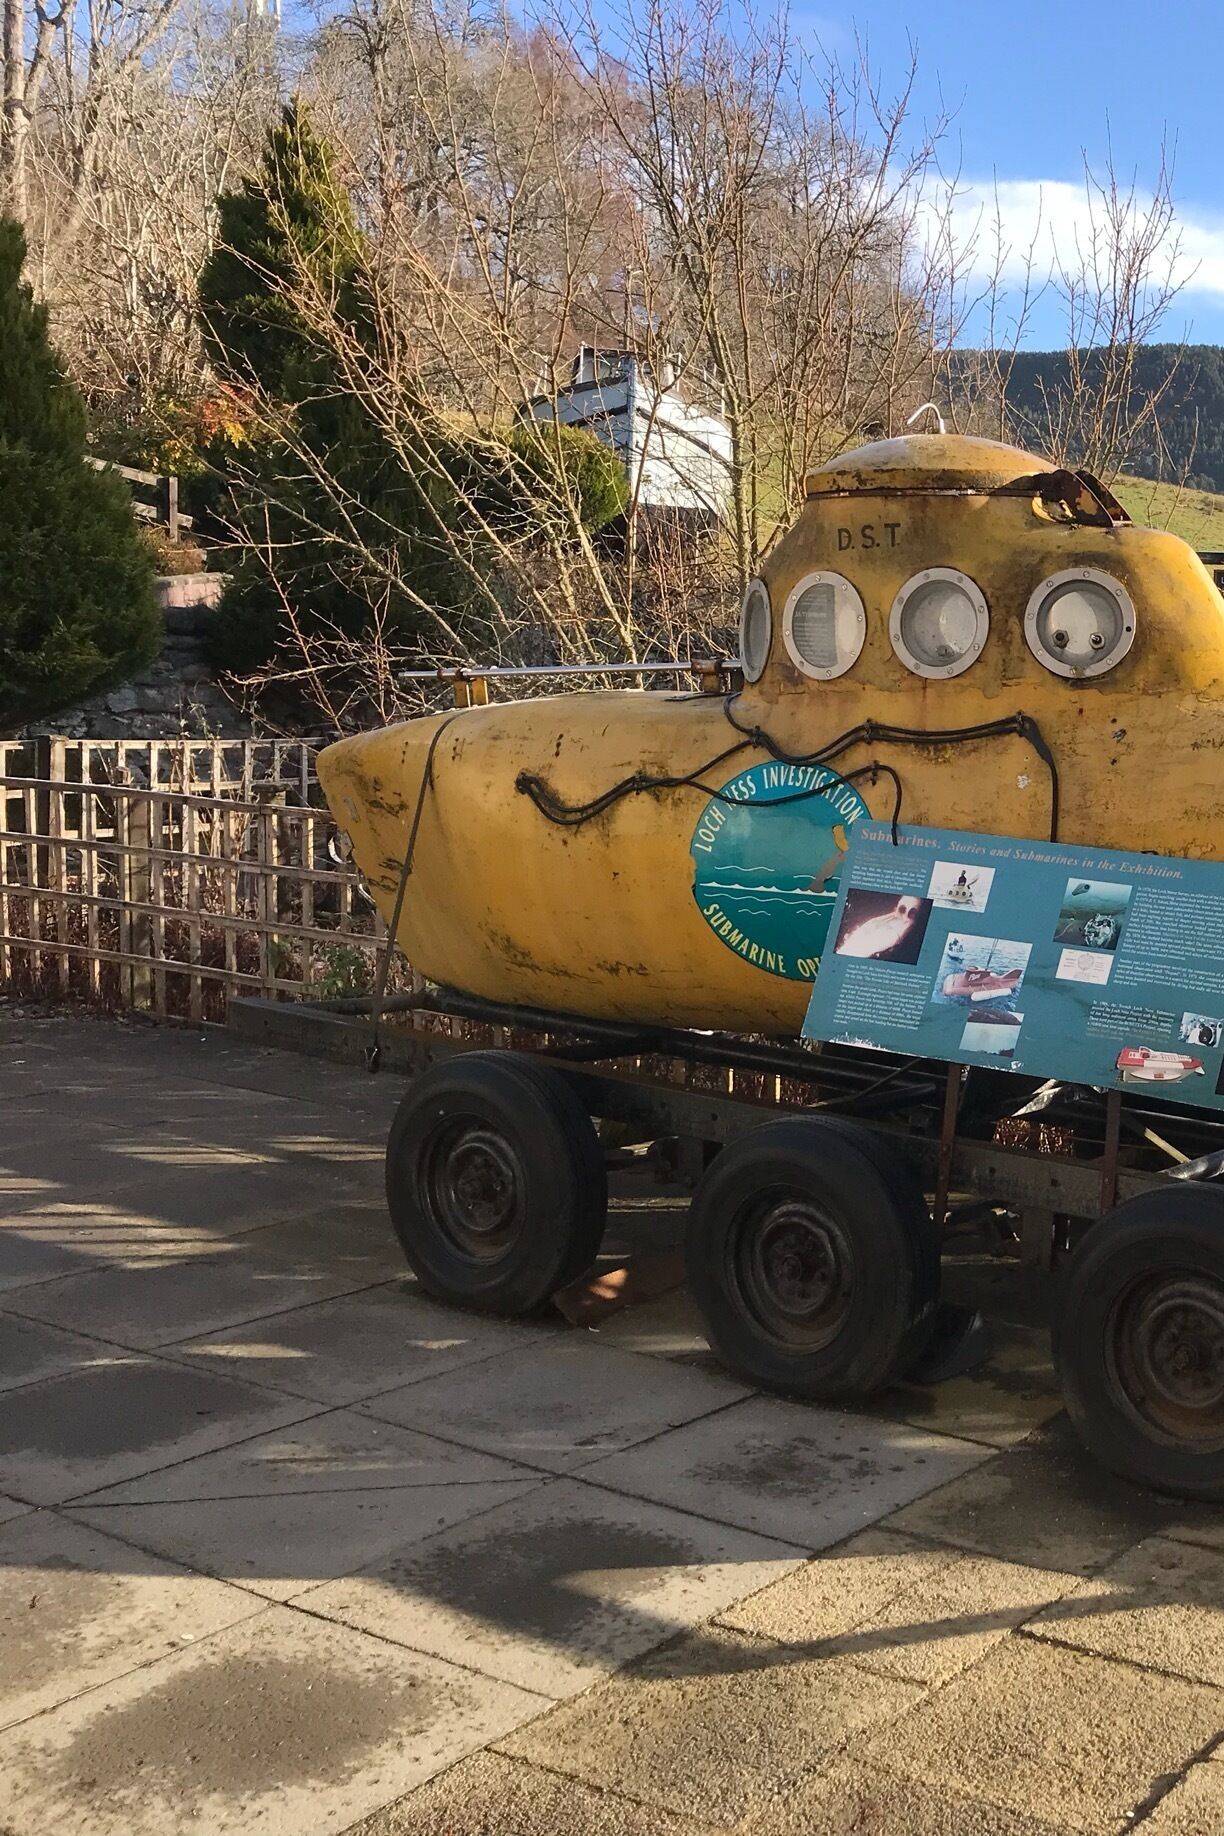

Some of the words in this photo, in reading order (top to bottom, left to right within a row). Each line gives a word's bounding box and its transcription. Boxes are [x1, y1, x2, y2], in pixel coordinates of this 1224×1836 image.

[694, 805, 727, 853] LOCH
[948, 841, 986, 855] Stories
[990, 847, 1012, 858] and
[1012, 849, 1079, 866] Submarines
[1082, 855, 1095, 868] in
[1098, 857, 1117, 870] the
[1119, 861, 1184, 880] Exhibition.
[703, 903, 787, 974] SUBMARINE
